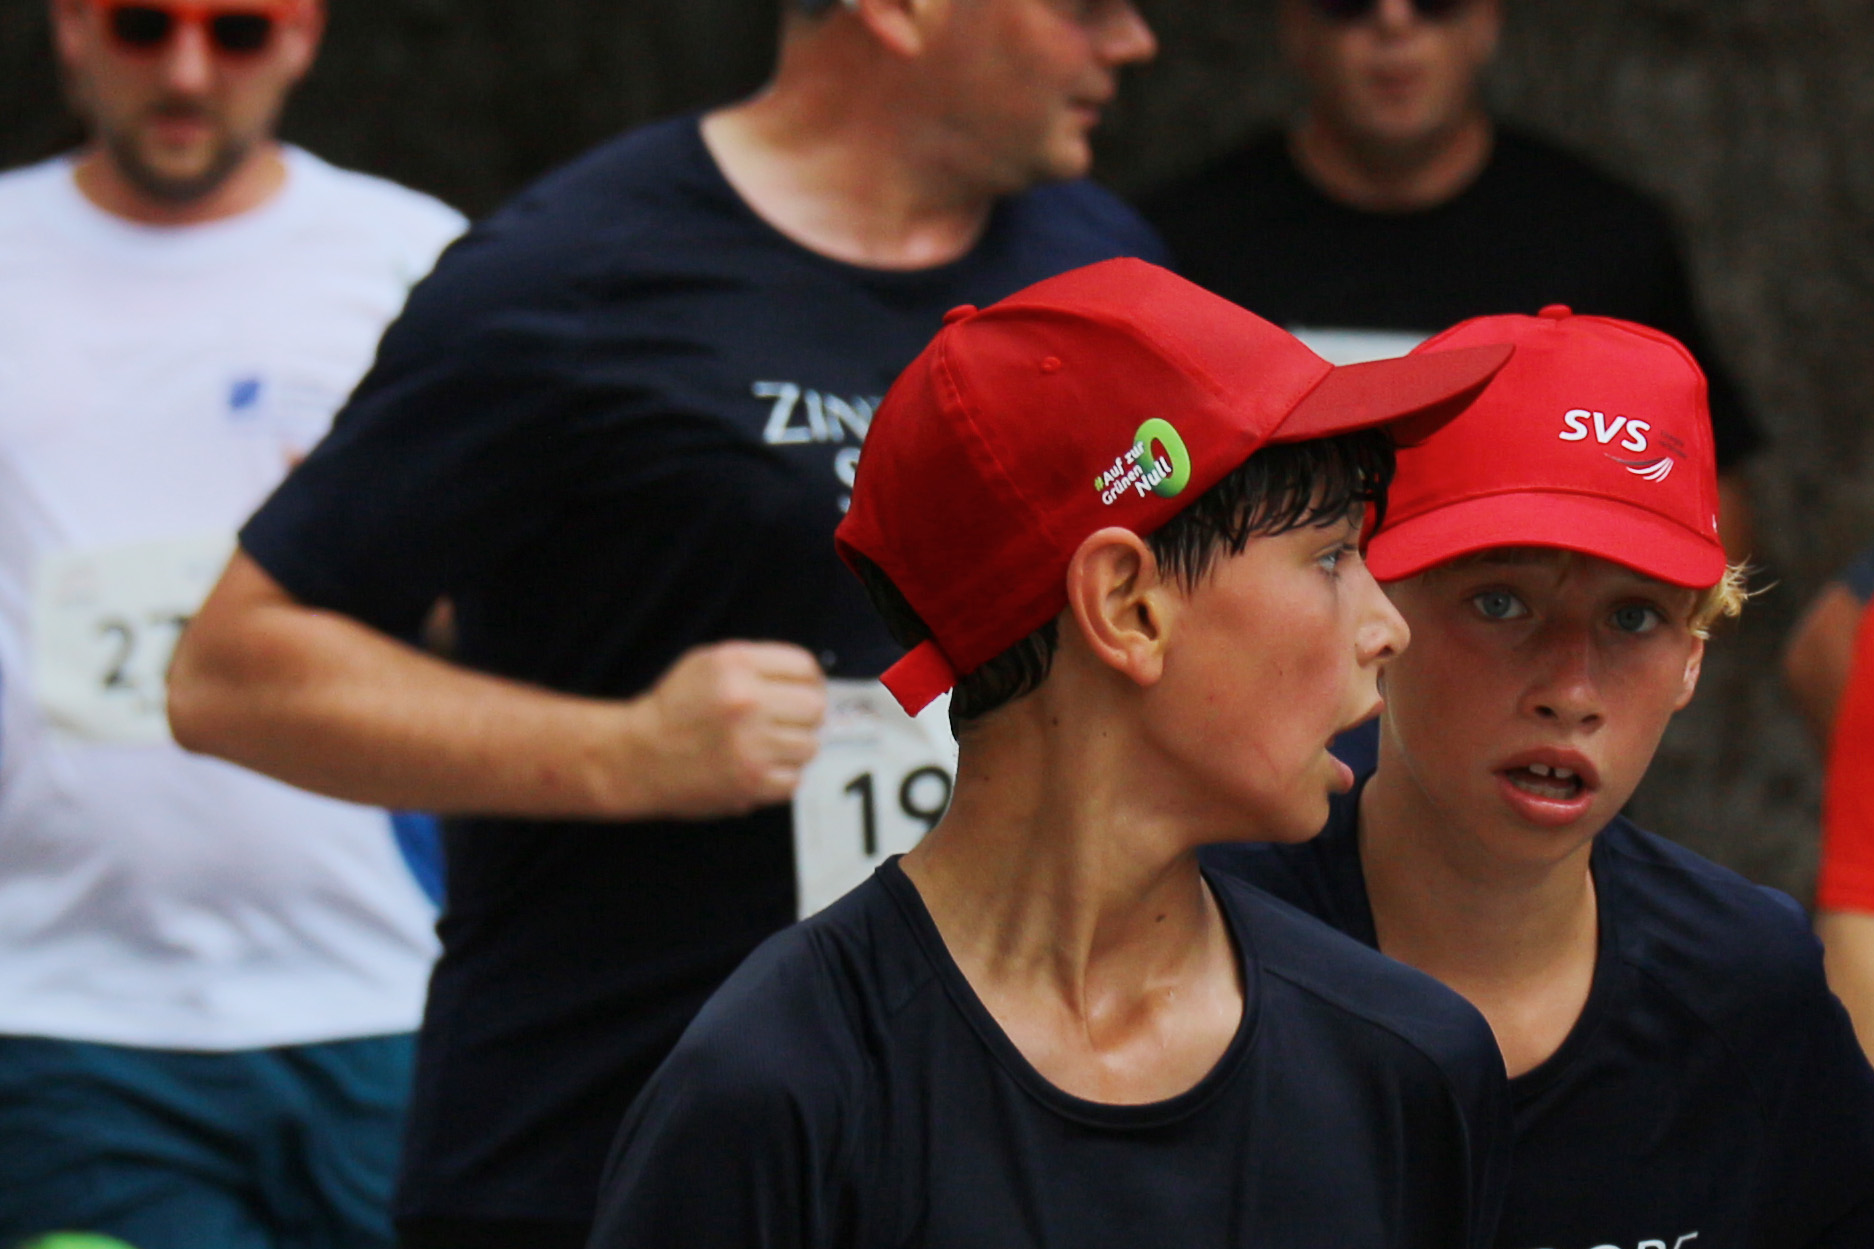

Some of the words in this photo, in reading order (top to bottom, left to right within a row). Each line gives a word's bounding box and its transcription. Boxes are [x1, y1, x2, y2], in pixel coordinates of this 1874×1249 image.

[752, 380, 880, 444] ZIN
[1558, 409, 1651, 452] SVS
[1094, 457, 1124, 492] #Auf
[1124, 441, 1145, 465] zur
[1101, 464, 1143, 506] Grünen
[1134, 455, 1172, 498] Null
